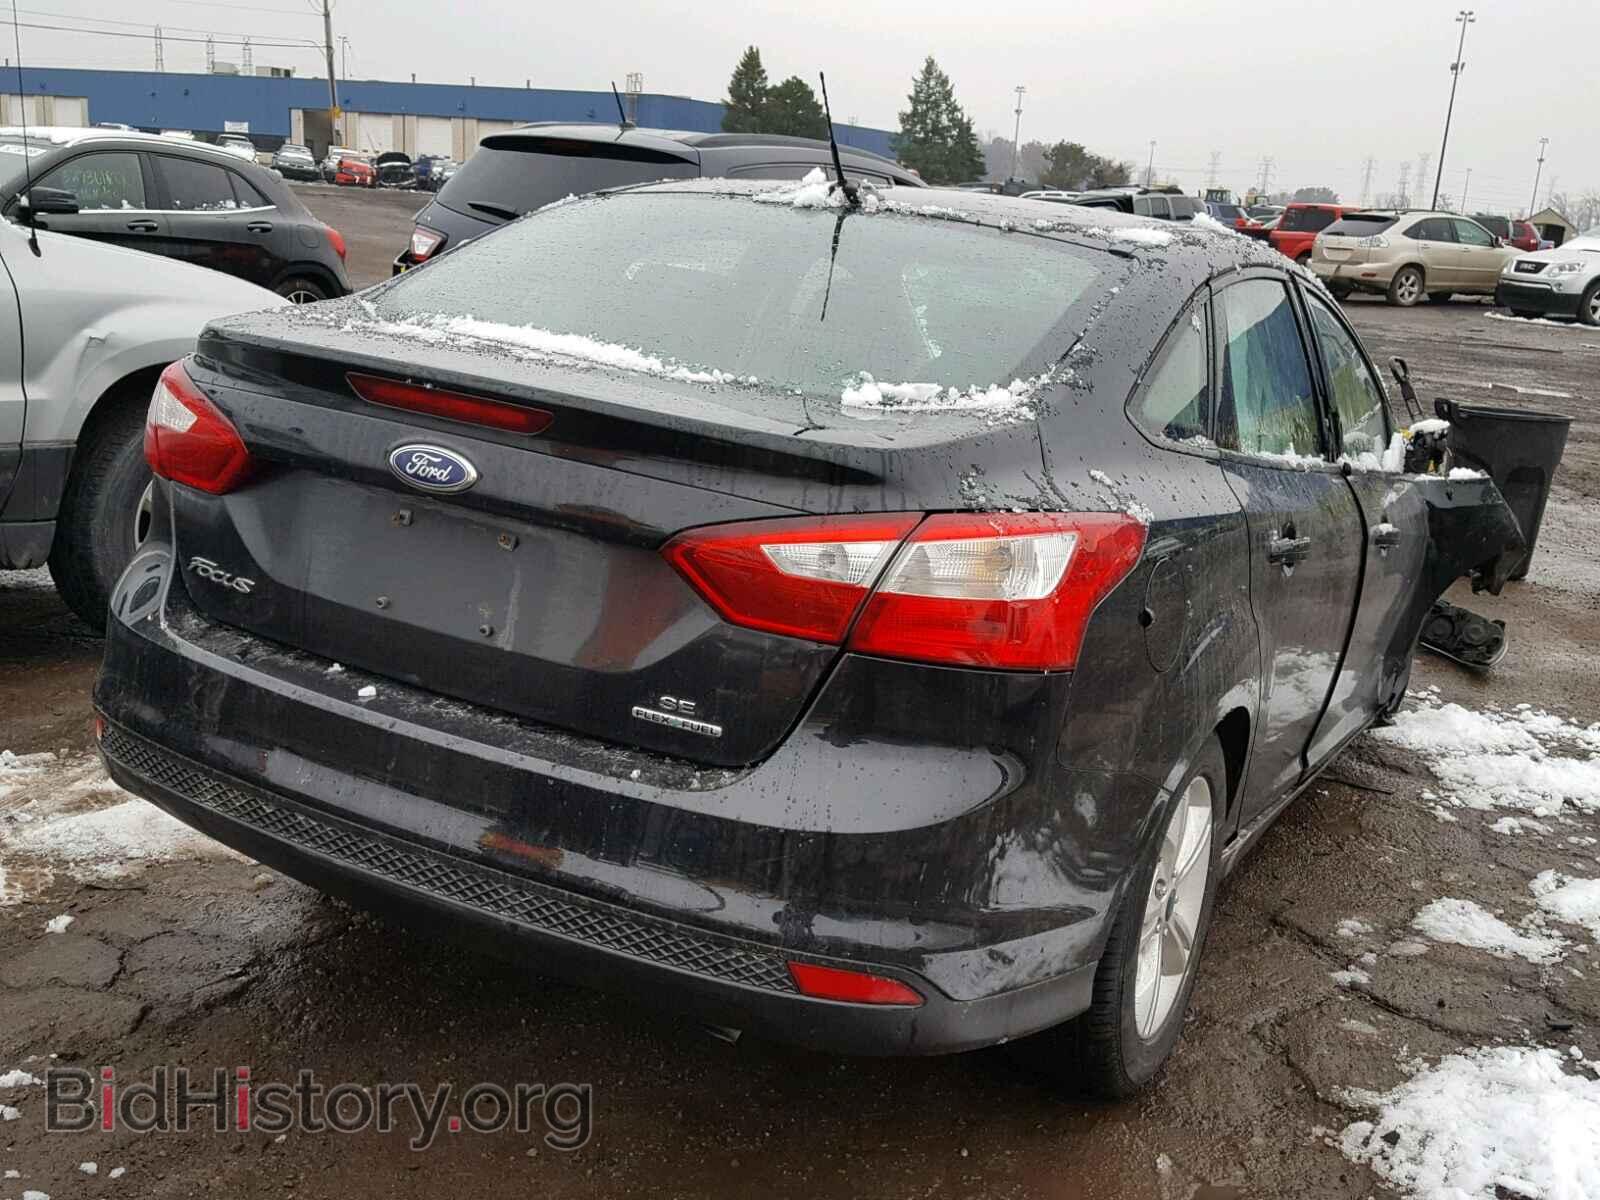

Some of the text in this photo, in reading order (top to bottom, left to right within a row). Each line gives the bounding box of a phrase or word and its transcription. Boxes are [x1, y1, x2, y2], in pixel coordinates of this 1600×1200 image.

[405, 452, 452, 481] Ford
[659, 695, 697, 716] SE
[635, 708, 721, 737] FLEX FUEL
